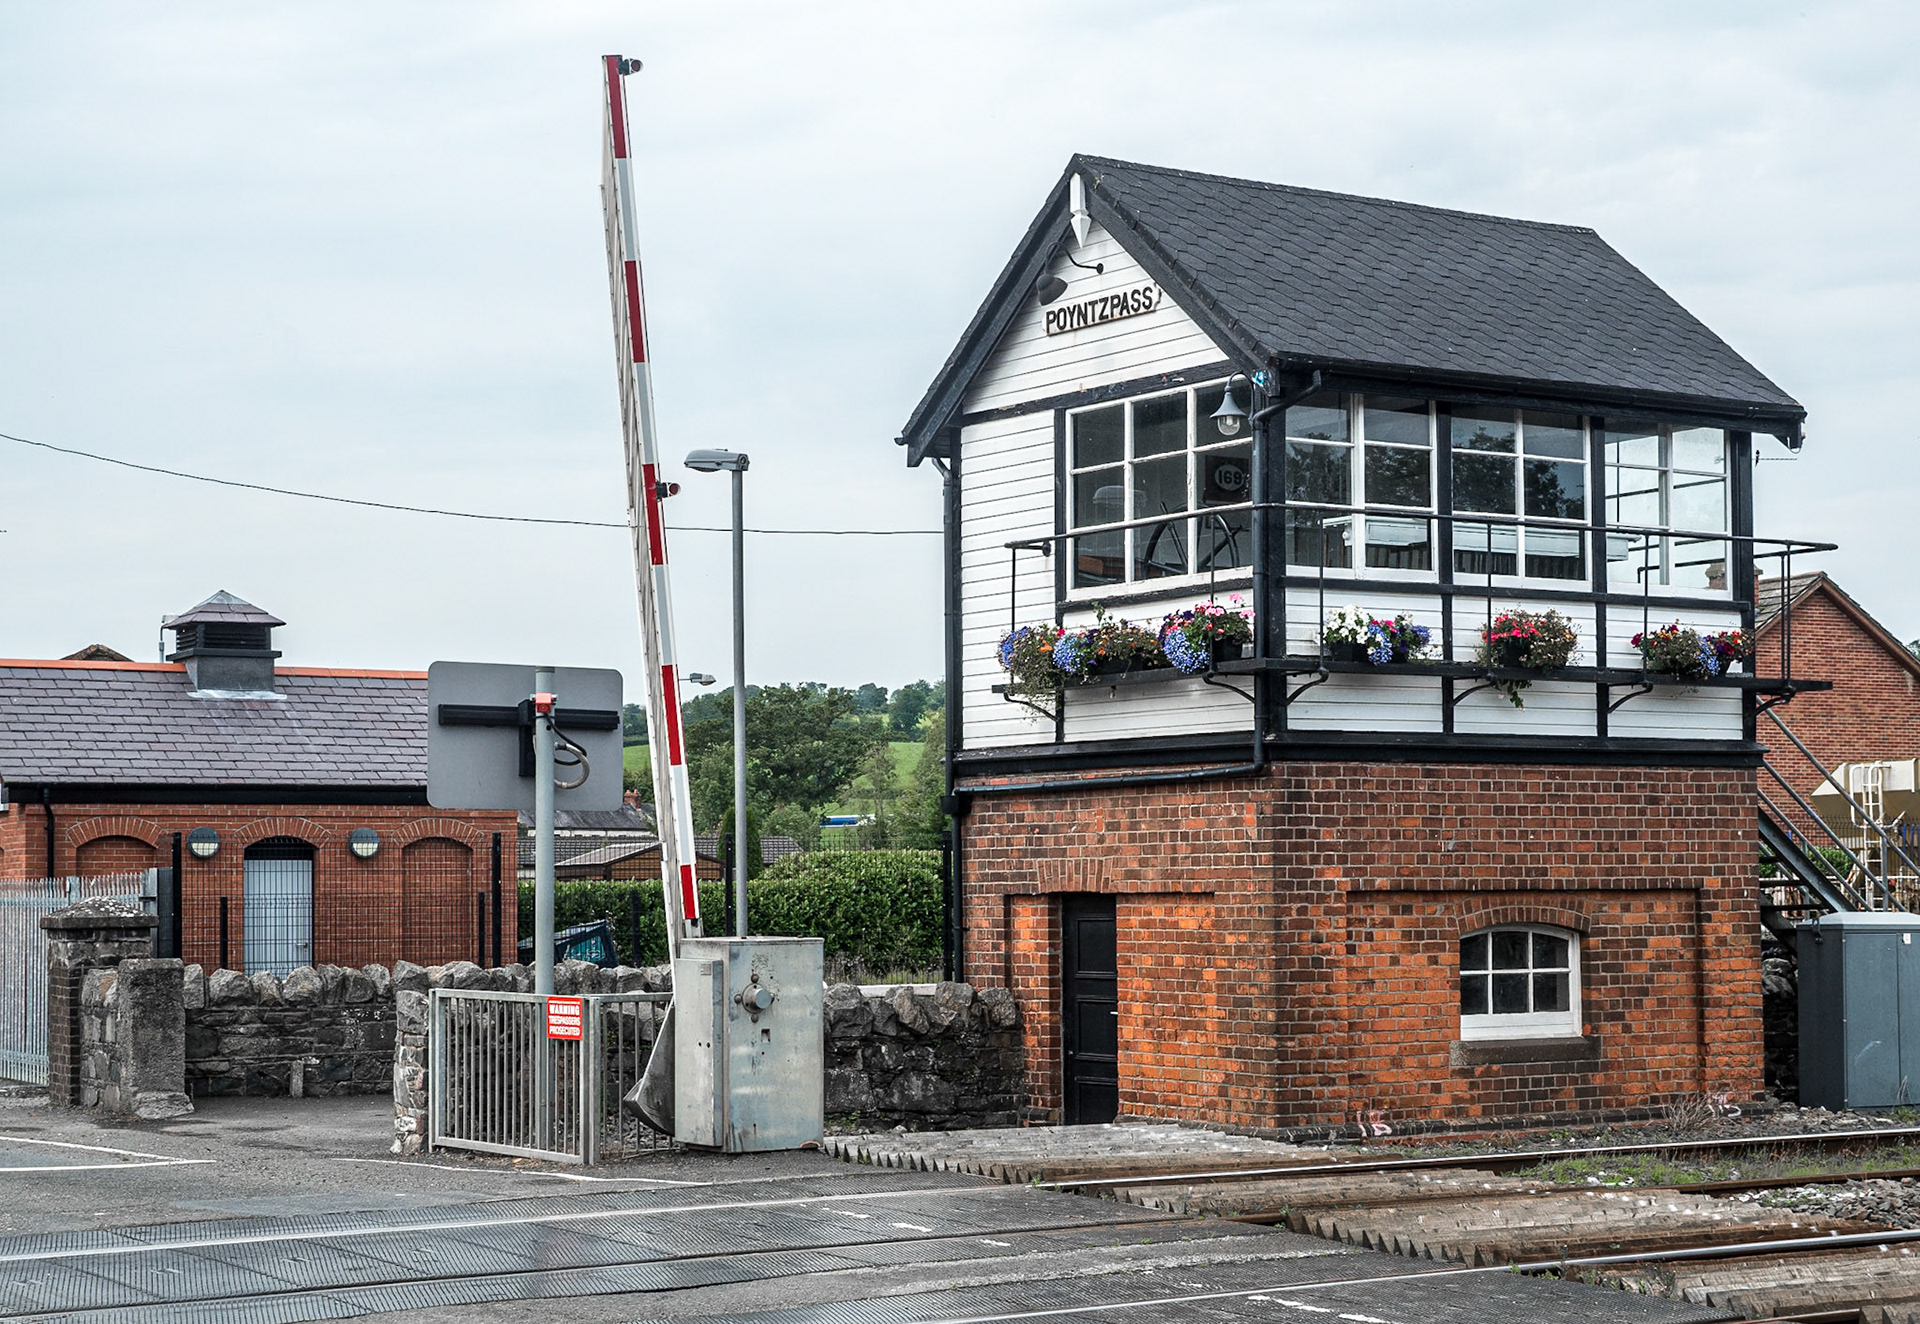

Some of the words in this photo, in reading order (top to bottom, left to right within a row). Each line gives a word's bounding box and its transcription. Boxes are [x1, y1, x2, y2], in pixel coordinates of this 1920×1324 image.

[1046, 286, 1153, 334] POYNTZPASS
[1218, 470, 1243, 485] 169
[549, 1004, 580, 1015] WARNING
[549, 1015, 580, 1026] TRESPASSERS
[549, 1026, 580, 1036] PROSECUTED
